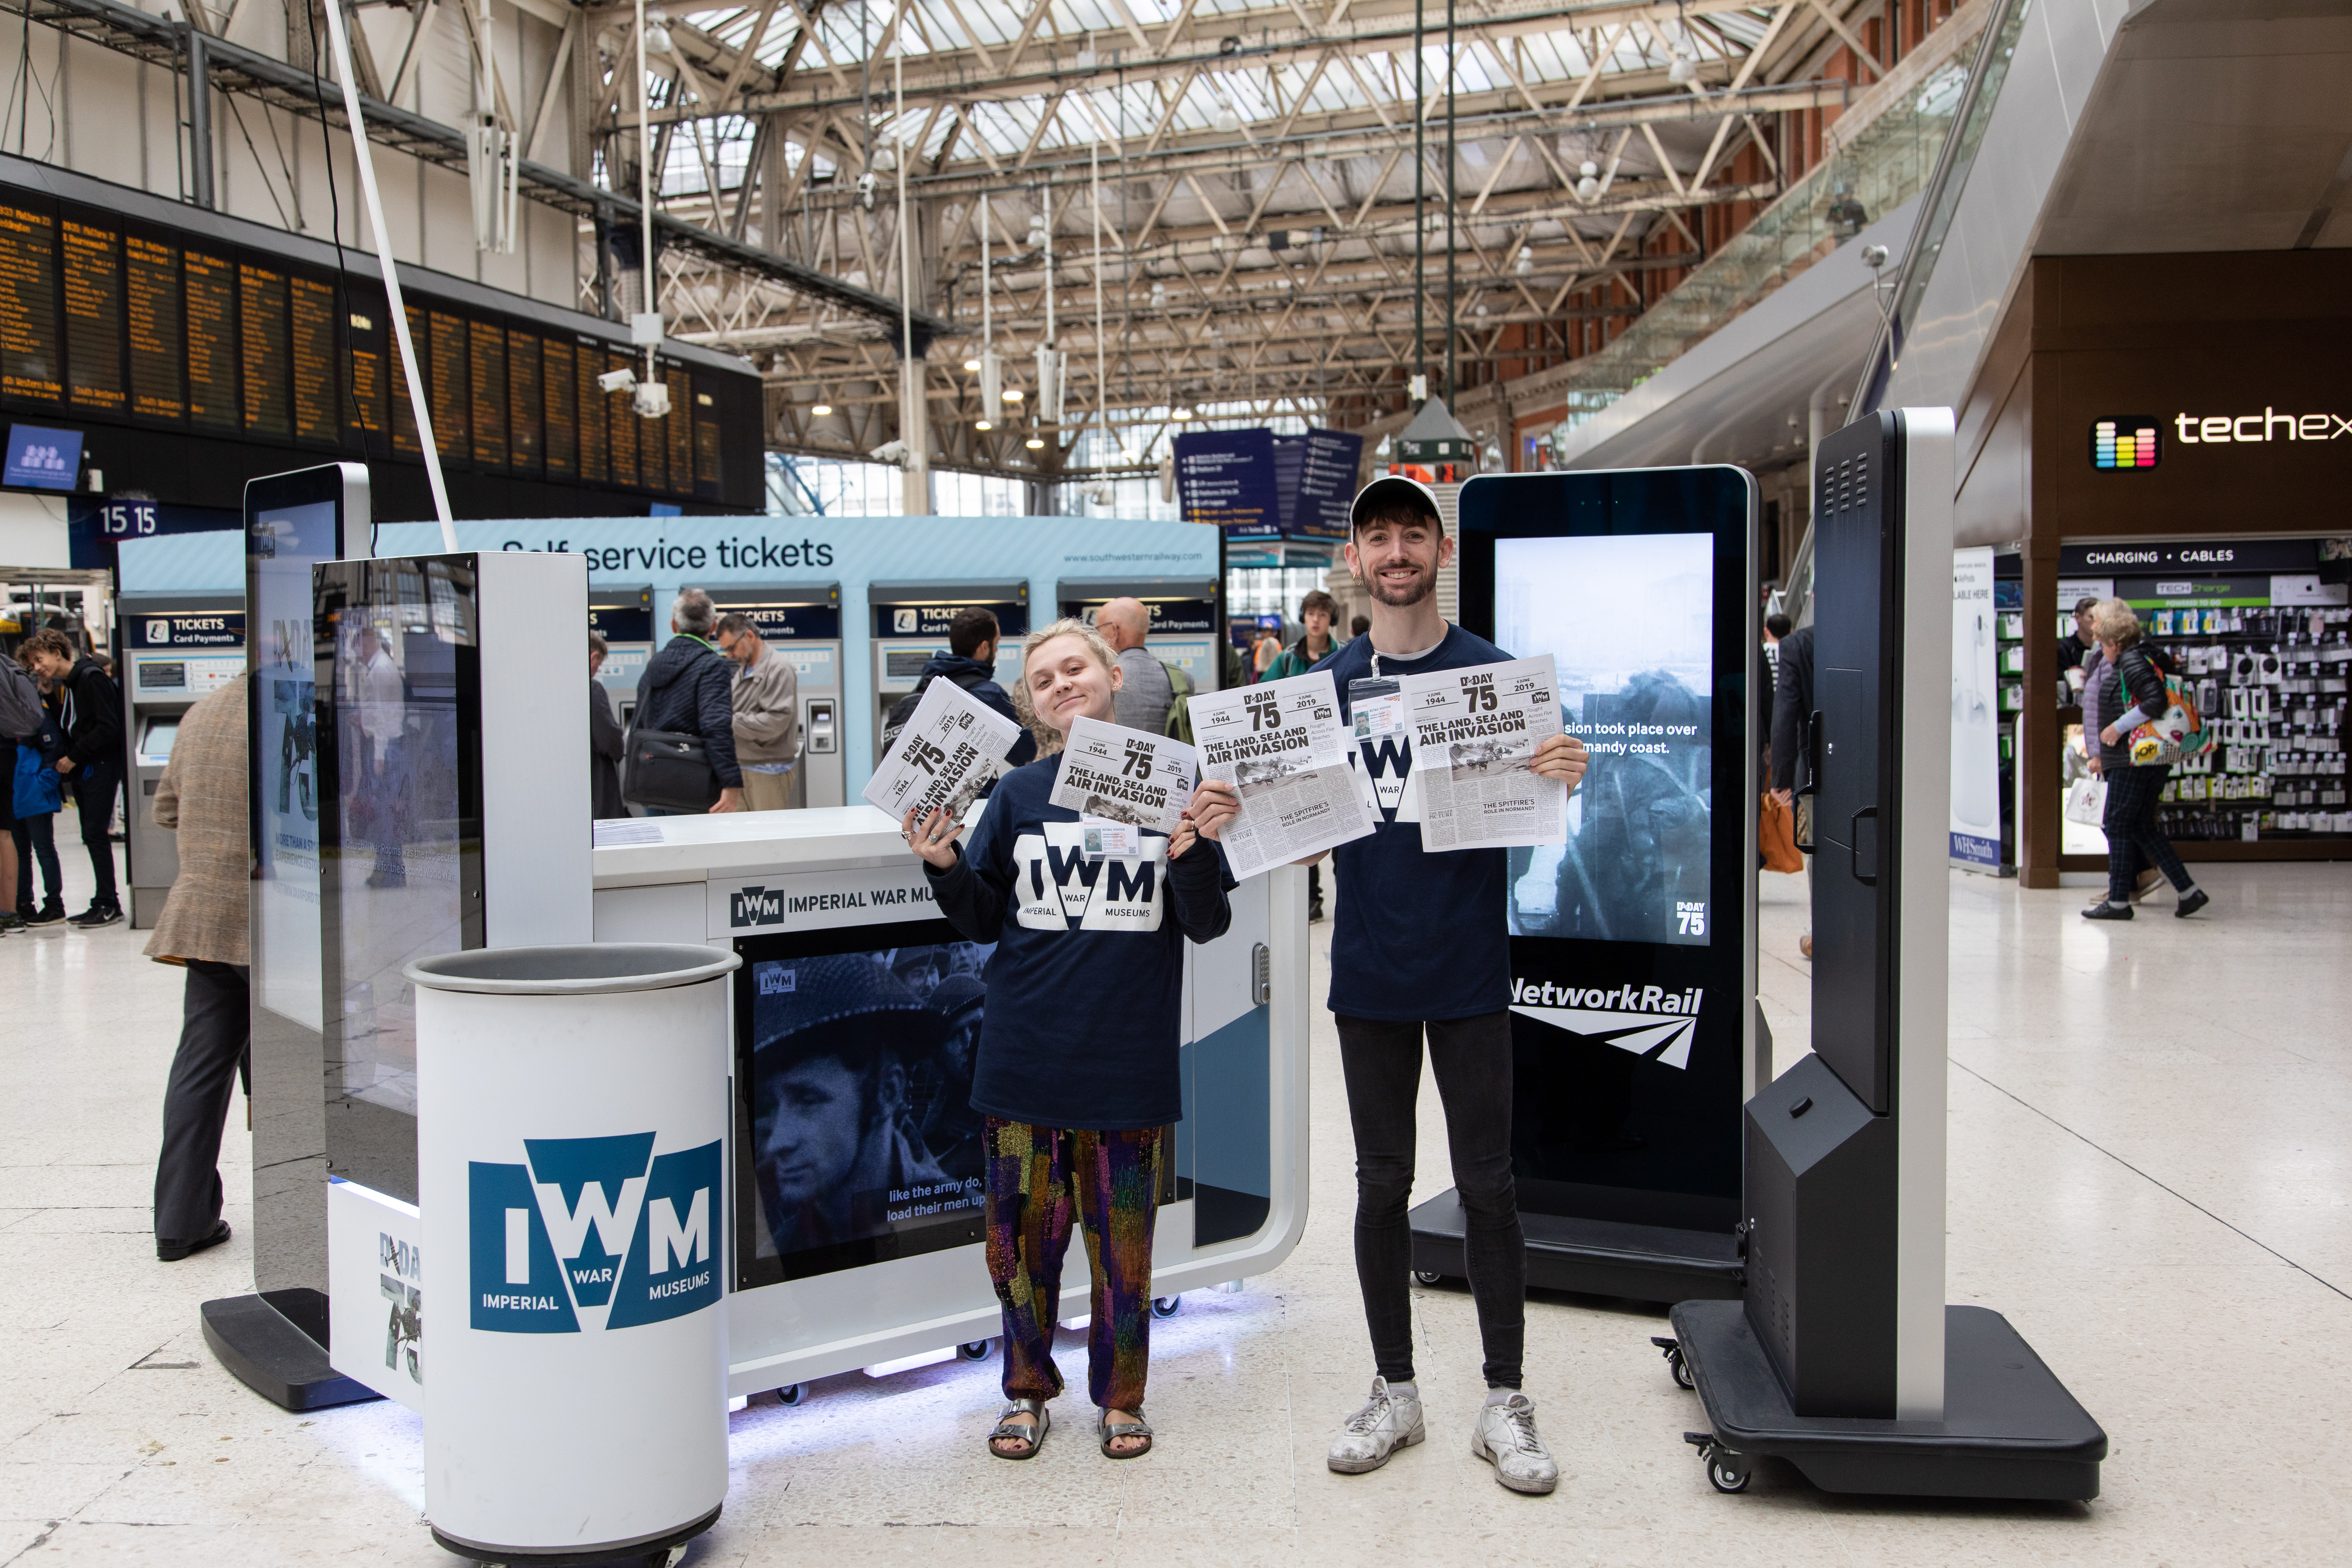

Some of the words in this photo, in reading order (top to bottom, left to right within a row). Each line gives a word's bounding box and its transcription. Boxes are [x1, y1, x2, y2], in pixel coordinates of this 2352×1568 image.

[100, 506, 127, 533] 15
[134, 507, 156, 534] 15
[585, 538, 706, 570] service
[716, 537, 833, 568] tickets
[1064, 552, 1202, 562] www.southwesternrailway.com
[2087, 552, 2158, 564] CHARGING
[2180, 550, 2234, 563] CABLES
[1973, 590, 1989, 599] HERE
[2158, 583, 2192, 594] TECH
[2192, 584, 2230, 593] Charge
[173, 618, 225, 630] TICKETS
[921, 624, 941, 632] Card
[1169, 621, 1210, 630] Payments
[174, 635, 193, 643] Card
[194, 634, 235, 644] Payments
[1514, 682, 1534, 692] 2019
[1297, 699, 1316, 708] 2019
[1426, 696, 1445, 705] 1944
[1462, 684, 1497, 713] 75
[941, 716, 955, 732] 2019
[1211, 715, 1230, 724] 1944
[1246, 702, 1281, 731] 75
[1417, 723, 1439, 734] THE
[1440, 718, 1474, 730] LAND,
[1476, 714, 1498, 724] SEA
[1500, 710, 1523, 721] AND
[966, 726, 976, 740] Fought
[971, 731, 981, 743] Across
[1420, 731, 1447, 747] AIR
[1448, 718, 1526, 742] INVASION
[1595, 722, 1626, 735] took
[1628, 723, 1663, 737] place
[1666, 726, 1697, 735] over
[975, 731, 988, 746] Beaches
[1204, 742, 1224, 753] THE
[1226, 737, 1258, 749] LAND,
[1260, 731, 1282, 742] SEA
[1284, 727, 1306, 738] AND
[274, 680, 319, 821] 75
[1089, 746, 1107, 755] 1944
[1207, 750, 1233, 765] AIR
[1234, 735, 1309, 760] INVASION
[1630, 743, 1670, 753] coast.
[2135, 744, 2157, 760] POP!
[911, 741, 945, 776] 75
[1122, 750, 1153, 780] 75
[920, 780, 943, 802] LAND,
[939, 761, 956, 778] SEA
[952, 742, 968, 762] AND
[931, 747, 979, 806] INVASION
[1167, 765, 1182, 773] 2019
[895, 780, 909, 796] 1944
[1069, 766, 1090, 778] THE
[1090, 771, 1121, 786] LAND,
[1124, 780, 1144, 792] SEA
[1145, 785, 1167, 796] AND
[1064, 775, 1092, 791] AIR
[1093, 781, 1166, 808] INVASION
[1280, 813, 1294, 822] THE
[1302, 807, 1330, 821] NORMANDY
[276, 832, 289, 846] MORE
[290, 836, 302, 850] THAN
[304, 839, 307, 850] A
[1230, 831, 1253, 843] PICTURE
[346, 839, 369, 851] Churchill
[370, 842, 380, 853] War
[381, 843, 401, 856] Rooms
[402, 848, 413, 858] was
[414, 848, 425, 860] the
[425, 851, 436, 863] top
[437, 852, 457, 863] secret
[1954, 835, 1992, 859] WHSmith
[276, 850, 303, 867] EXPERIENCE
[347, 859, 362, 868] nerve
[363, 860, 381, 871] centre
[381, 861, 390, 872] for
[390, 862, 400, 873] the
[401, 863, 423, 876] Second
[424, 867, 442, 880] World
[1029, 843, 1156, 903] IWM
[734, 891, 783, 922] IWM
[789, 893, 867, 913] IMPERIAL
[871, 889, 907, 906] WAR
[1023, 907, 1057, 916] IMPERIAL
[1105, 908, 1150, 917] MUSEUMS
[1677, 912, 1705, 936] 75
[762, 970, 794, 991] IWM
[889, 1190, 910, 1202] like
[912, 1186, 931, 1198] the
[934, 1181, 963, 1194] army
[965, 1177, 982, 1188] do,
[887, 1207, 911, 1222] load
[914, 1201, 942, 1216] their
[944, 1198, 969, 1211] men
[972, 1196, 985, 1207] up
[500, 1168, 712, 1289] IWM
[573, 1268, 612, 1284] WAR
[650, 1271, 709, 1300] MUSEUMS
[483, 1293, 559, 1310] IMPERIAL
